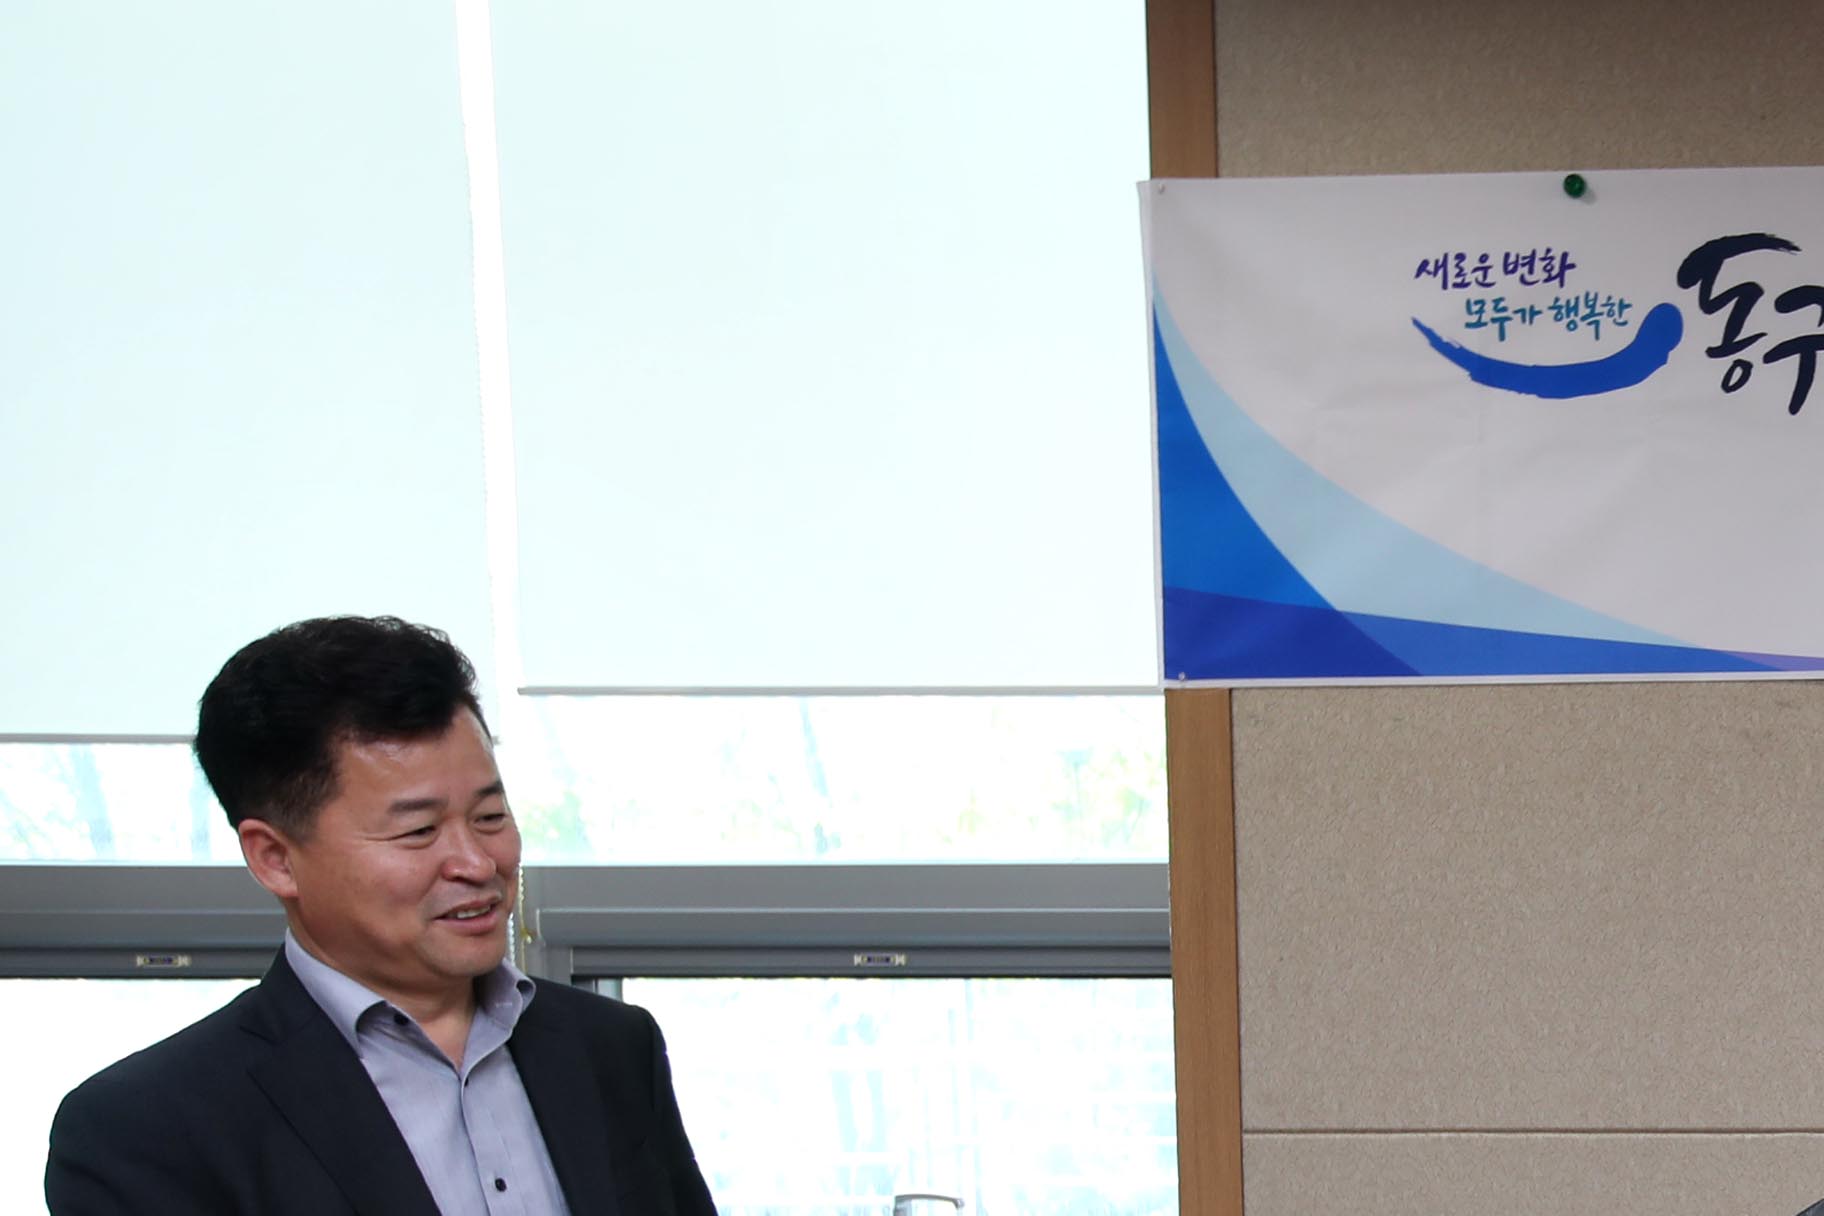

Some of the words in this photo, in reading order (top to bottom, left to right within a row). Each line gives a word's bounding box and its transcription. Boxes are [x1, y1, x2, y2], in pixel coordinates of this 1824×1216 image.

[1414, 252, 1497, 290] 새로운
[1503, 247, 1577, 289] 변화
[1464, 296, 1543, 342] 모두가
[1547, 290, 1633, 341] 행복한
